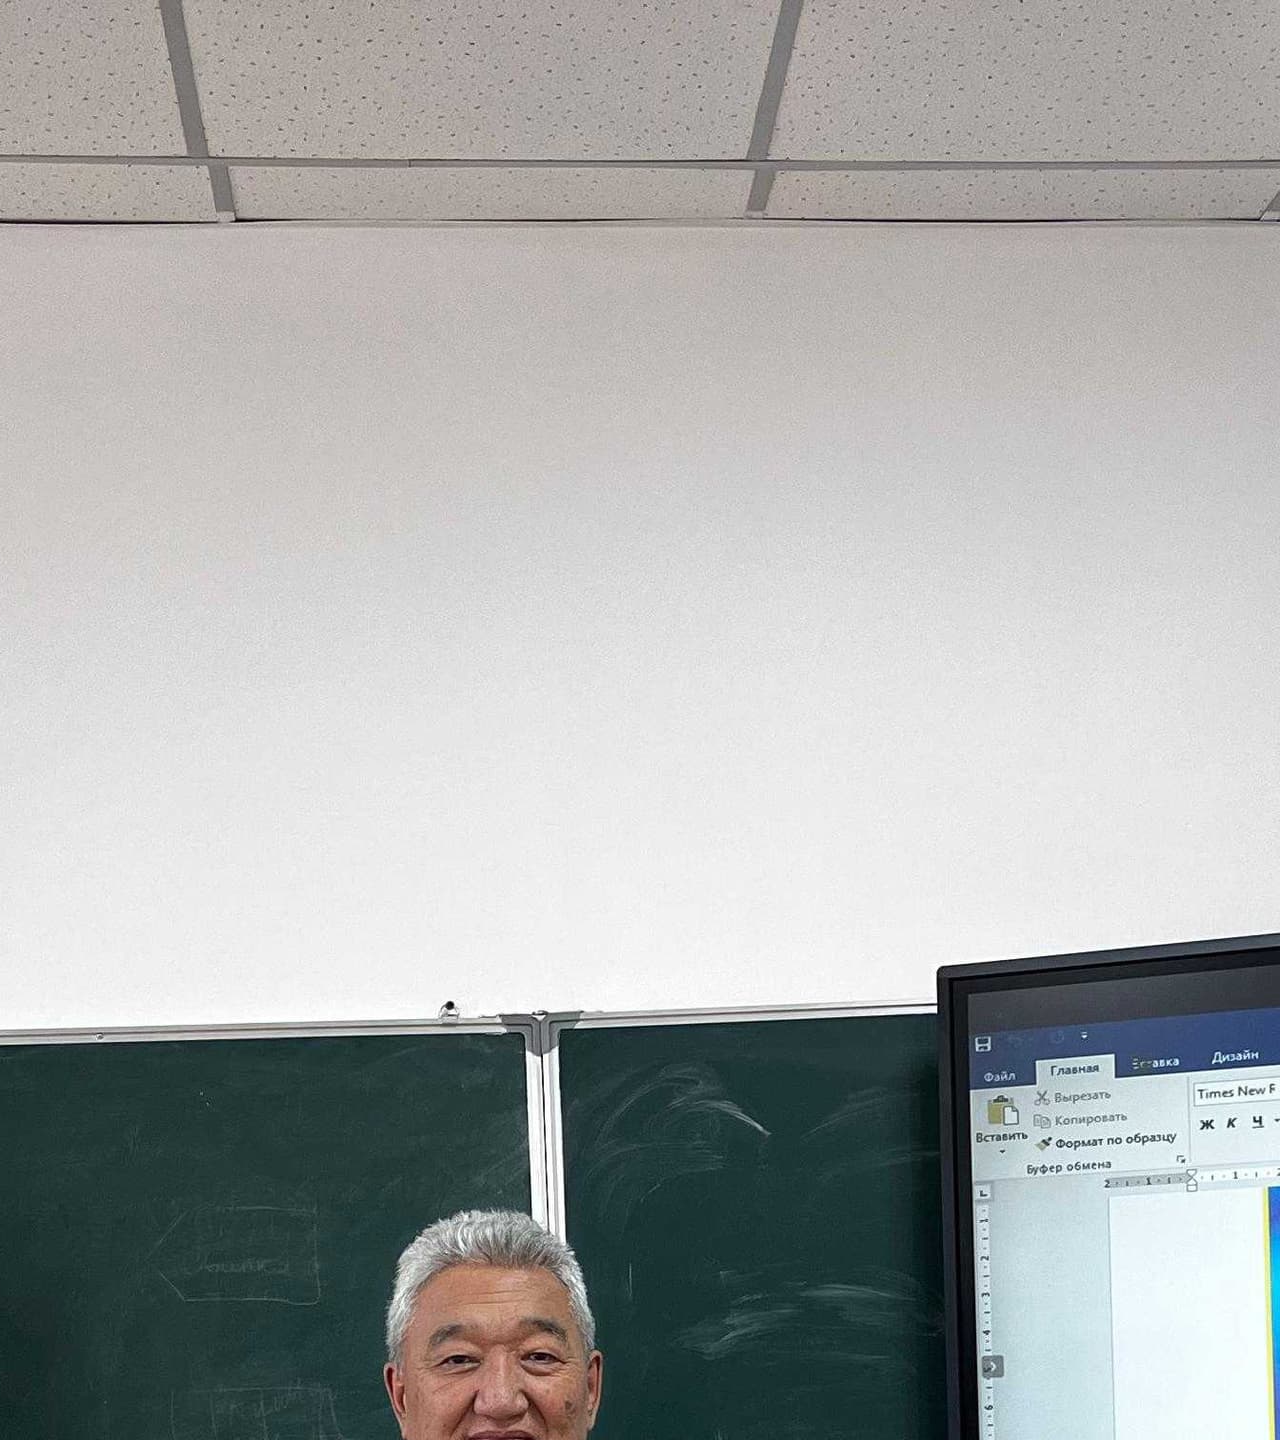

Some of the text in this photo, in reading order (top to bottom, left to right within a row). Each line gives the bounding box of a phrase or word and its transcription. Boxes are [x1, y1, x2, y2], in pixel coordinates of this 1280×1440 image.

[984, 1071, 1016, 1083] Файл
[1050, 1064, 1100, 1077] Главная
[1212, 1050, 1259, 1064] Дизайн
[1054, 1090, 1112, 1104] Вырезать
[1198, 1087, 1235, 1100] Times
[1238, 1085, 1267, 1097] New
[1055, 1112, 1128, 1127] Копировать
[1200, 1119, 1215, 1131] Ж
[976, 1131, 1029, 1144] Вставить
[1055, 1131, 1177, 1151] Формат по образцу
[1026, 1159, 1113, 1176] Буфер обмена
